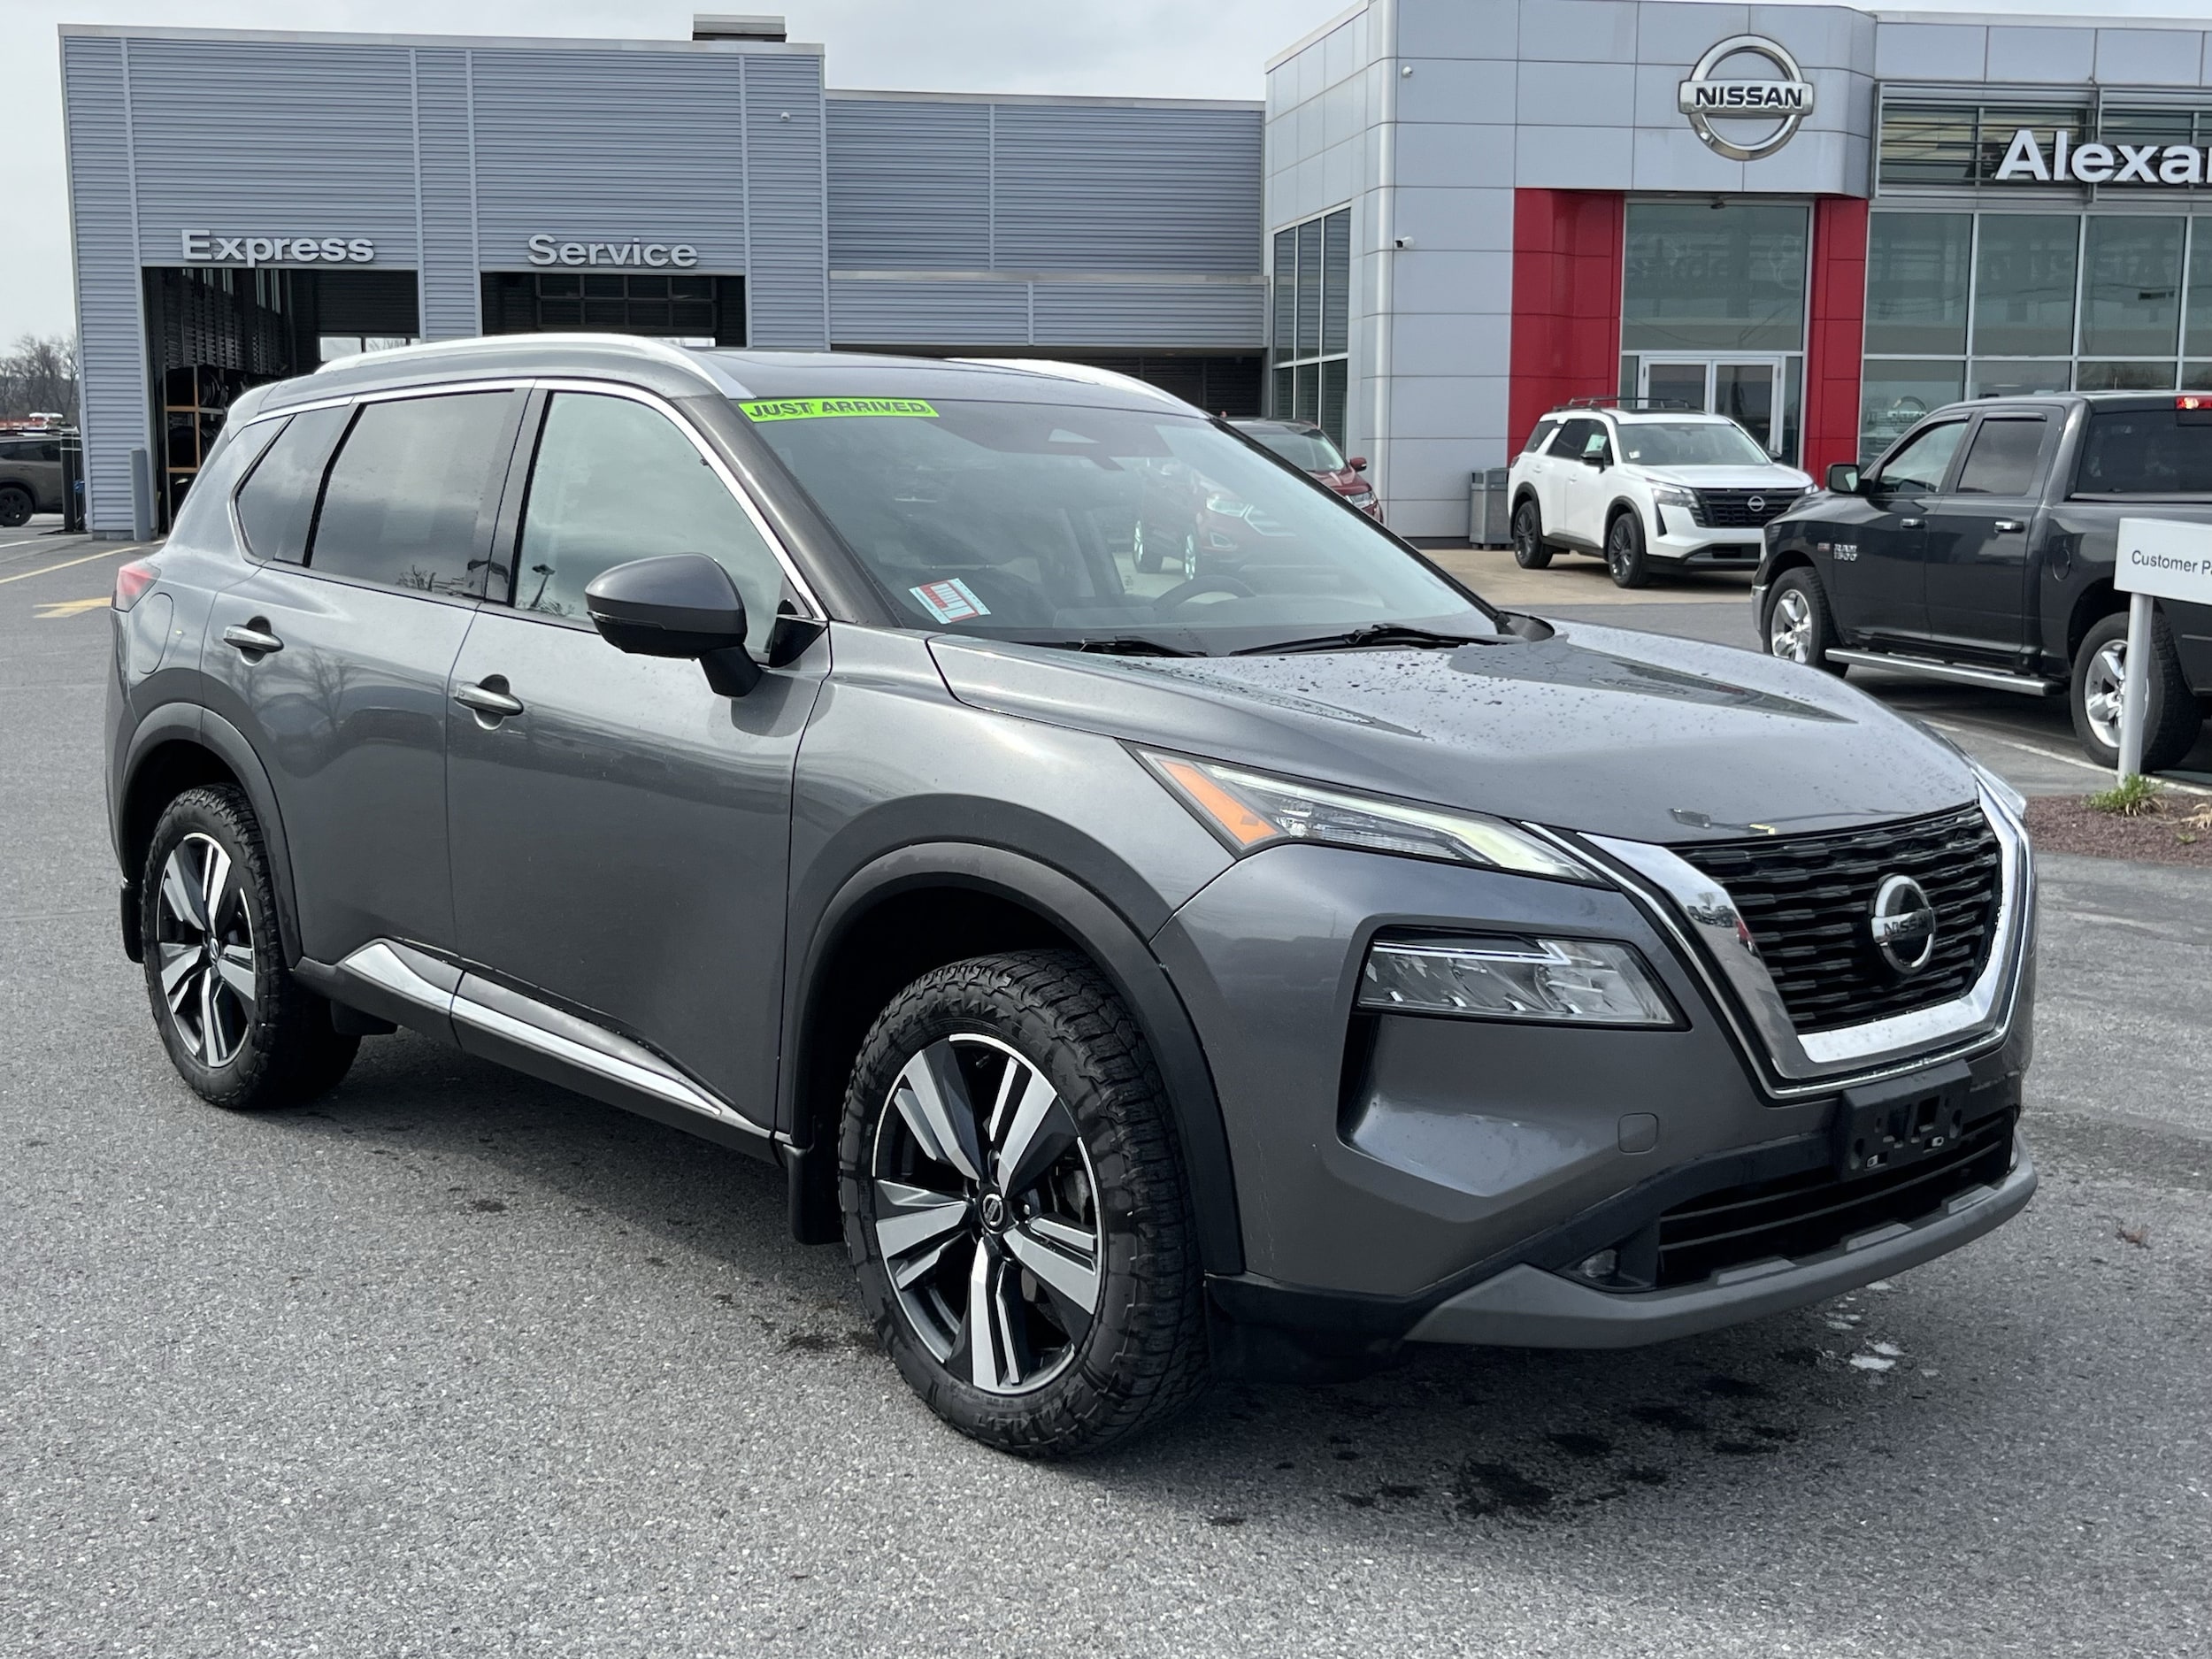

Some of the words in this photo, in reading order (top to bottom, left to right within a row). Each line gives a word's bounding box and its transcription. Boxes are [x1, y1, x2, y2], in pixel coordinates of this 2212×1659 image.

[1695, 86, 1803, 108] NISSAN
[1994, 128, 2212, 184] Alexa
[181, 228, 376, 268] Express
[527, 234, 699, 267] Service
[749, 402, 811, 419] JUST
[821, 400, 932, 414] ARRIVED
[1834, 543, 1857, 553] RAM
[2131, 549, 2198, 573] Customer
[2201, 560, 2212, 575] P
[1883, 918, 1927, 936] NISS
